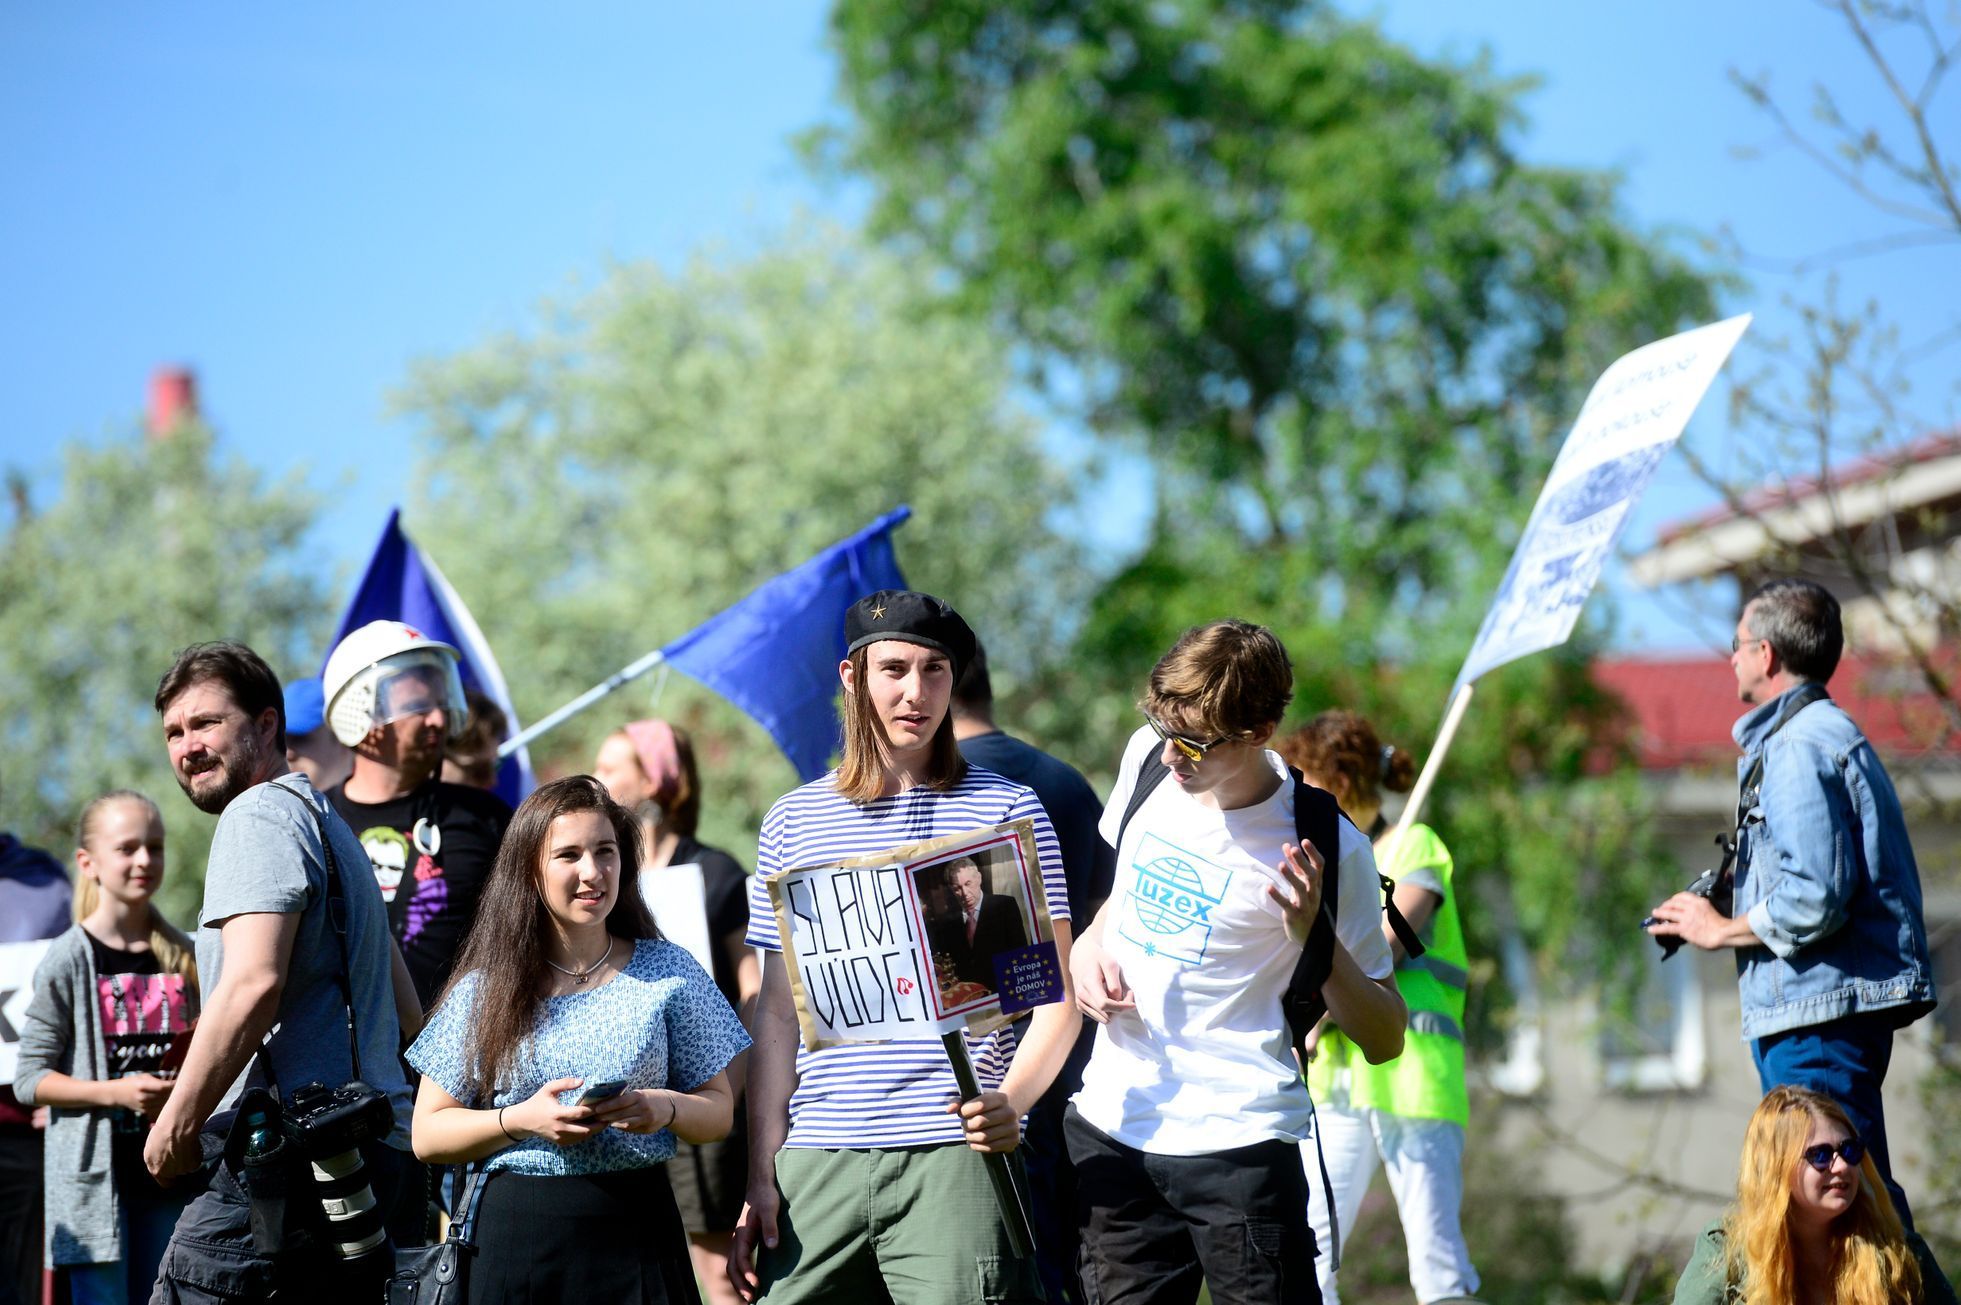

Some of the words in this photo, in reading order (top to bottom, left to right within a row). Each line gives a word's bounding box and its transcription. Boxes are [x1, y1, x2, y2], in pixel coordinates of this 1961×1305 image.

[1013, 961, 1041, 974] Evropa
[1016, 975, 1025, 985] je
[1026, 971, 1041, 981] náš
[1015, 979, 1045, 994] DOMOV
